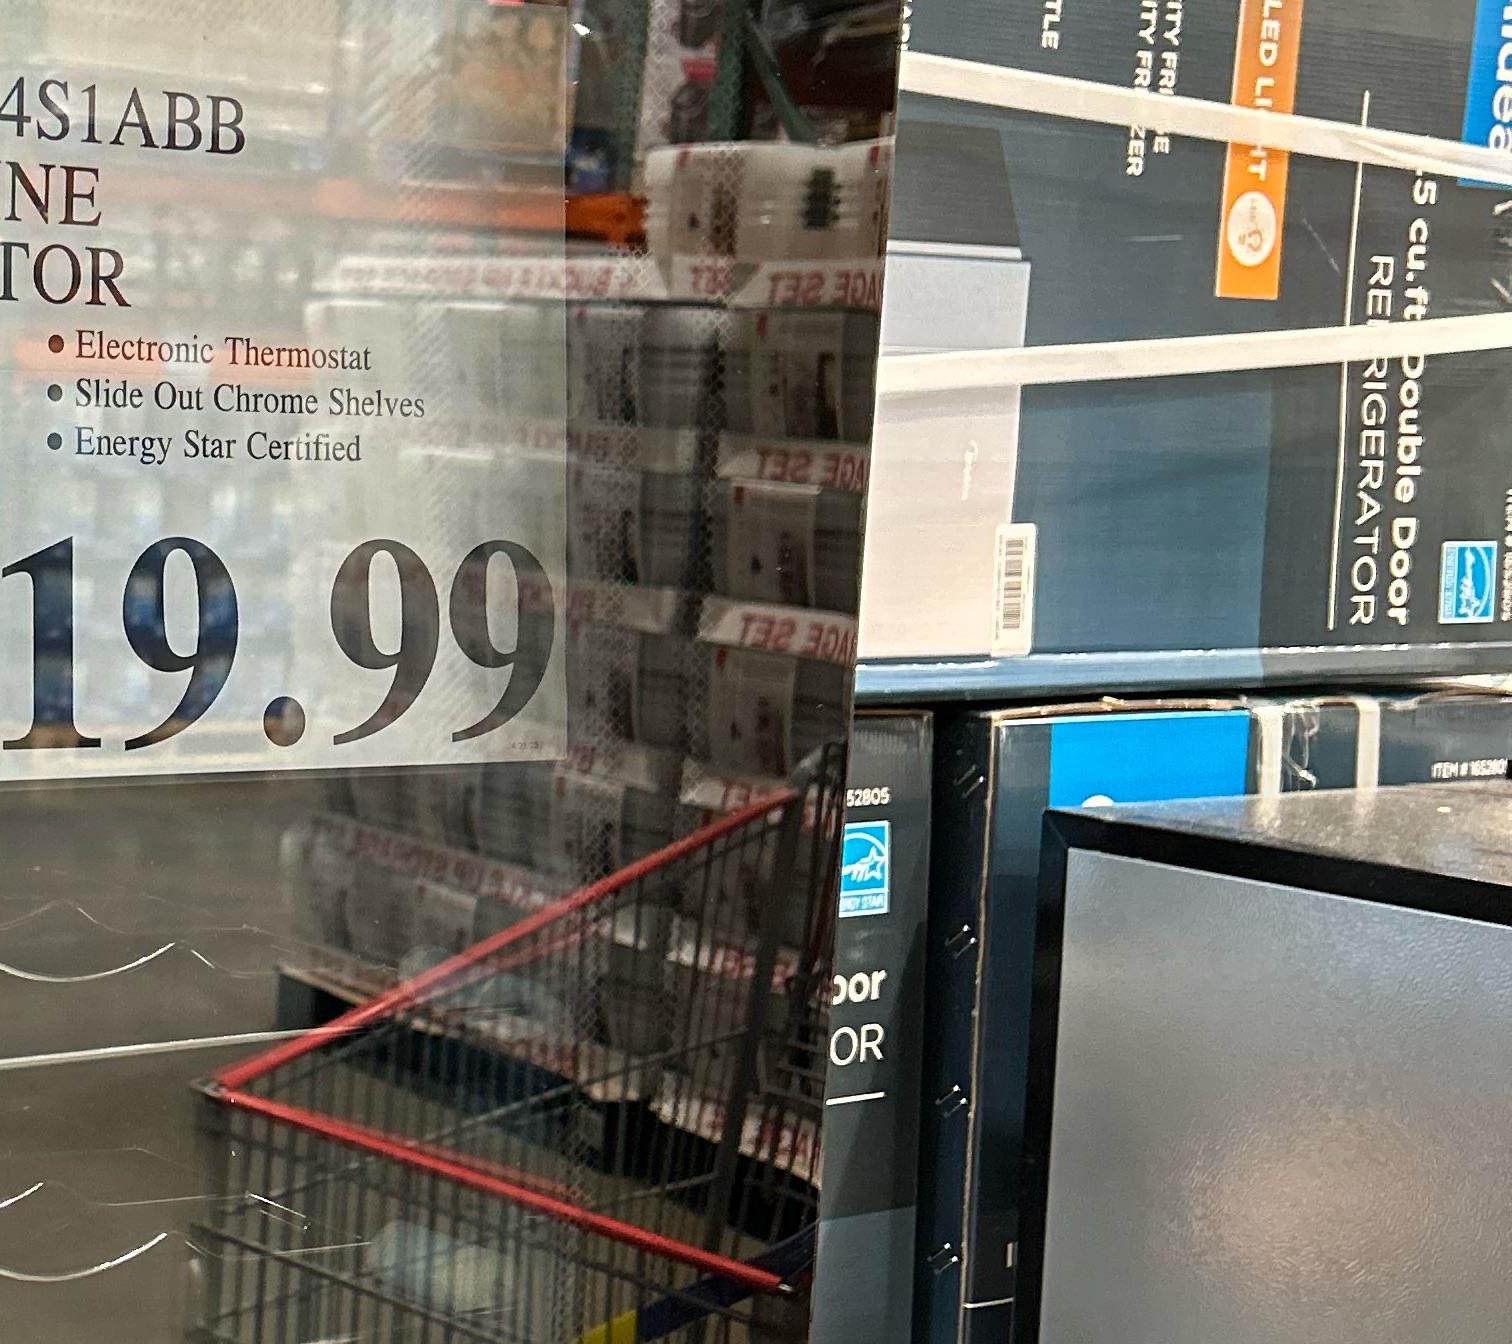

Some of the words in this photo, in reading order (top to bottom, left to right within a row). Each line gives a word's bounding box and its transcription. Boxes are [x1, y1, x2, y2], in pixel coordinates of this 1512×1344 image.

[1257, 0, 1284, 67] LED
[1125, 49, 1155, 177] FRZER
[1152, 50, 1180, 154] FRIE
[1246, 76, 1277, 182] LIHT
[74, 329, 215, 365] Electronic
[225, 336, 373, 372] Thermostat
[74, 378, 144, 410] Slide
[153, 381, 204, 412] Out
[212, 384, 319, 416] Chrome
[328, 387, 426, 419] Shelves
[74, 425, 173, 466] Energy
[182, 429, 237, 461] Star
[245, 431, 363, 463] Certified
[1350, 254, 1395, 626] RERIGERATOR
[1393, 354, 1426, 504] Double
[1387, 515, 1417, 626] Door
